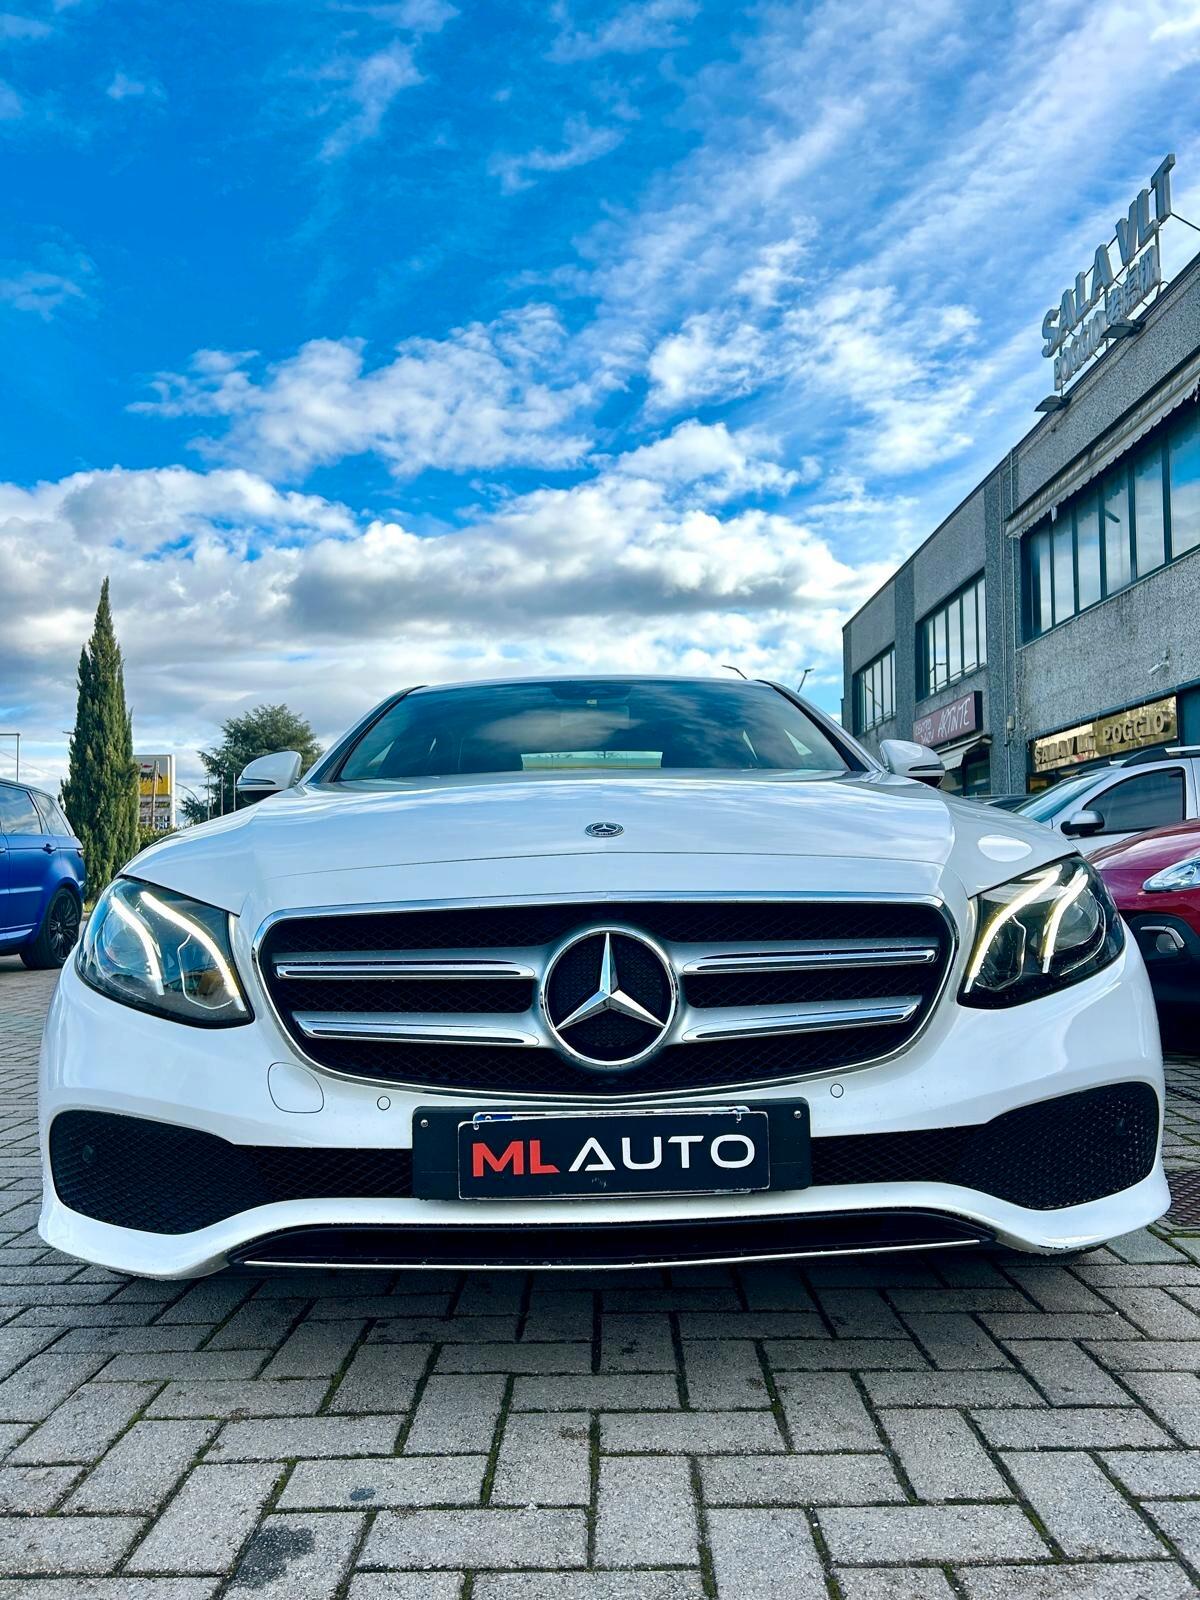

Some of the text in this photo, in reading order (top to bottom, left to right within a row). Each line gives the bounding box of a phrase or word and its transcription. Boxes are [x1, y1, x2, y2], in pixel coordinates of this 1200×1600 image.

[1042, 153, 1175, 357] SALA VLT
[1054, 310, 1107, 391] POGGIO
[1102, 711, 1168, 746] POGGIO
[472, 1134, 755, 1177] ML AUTO
